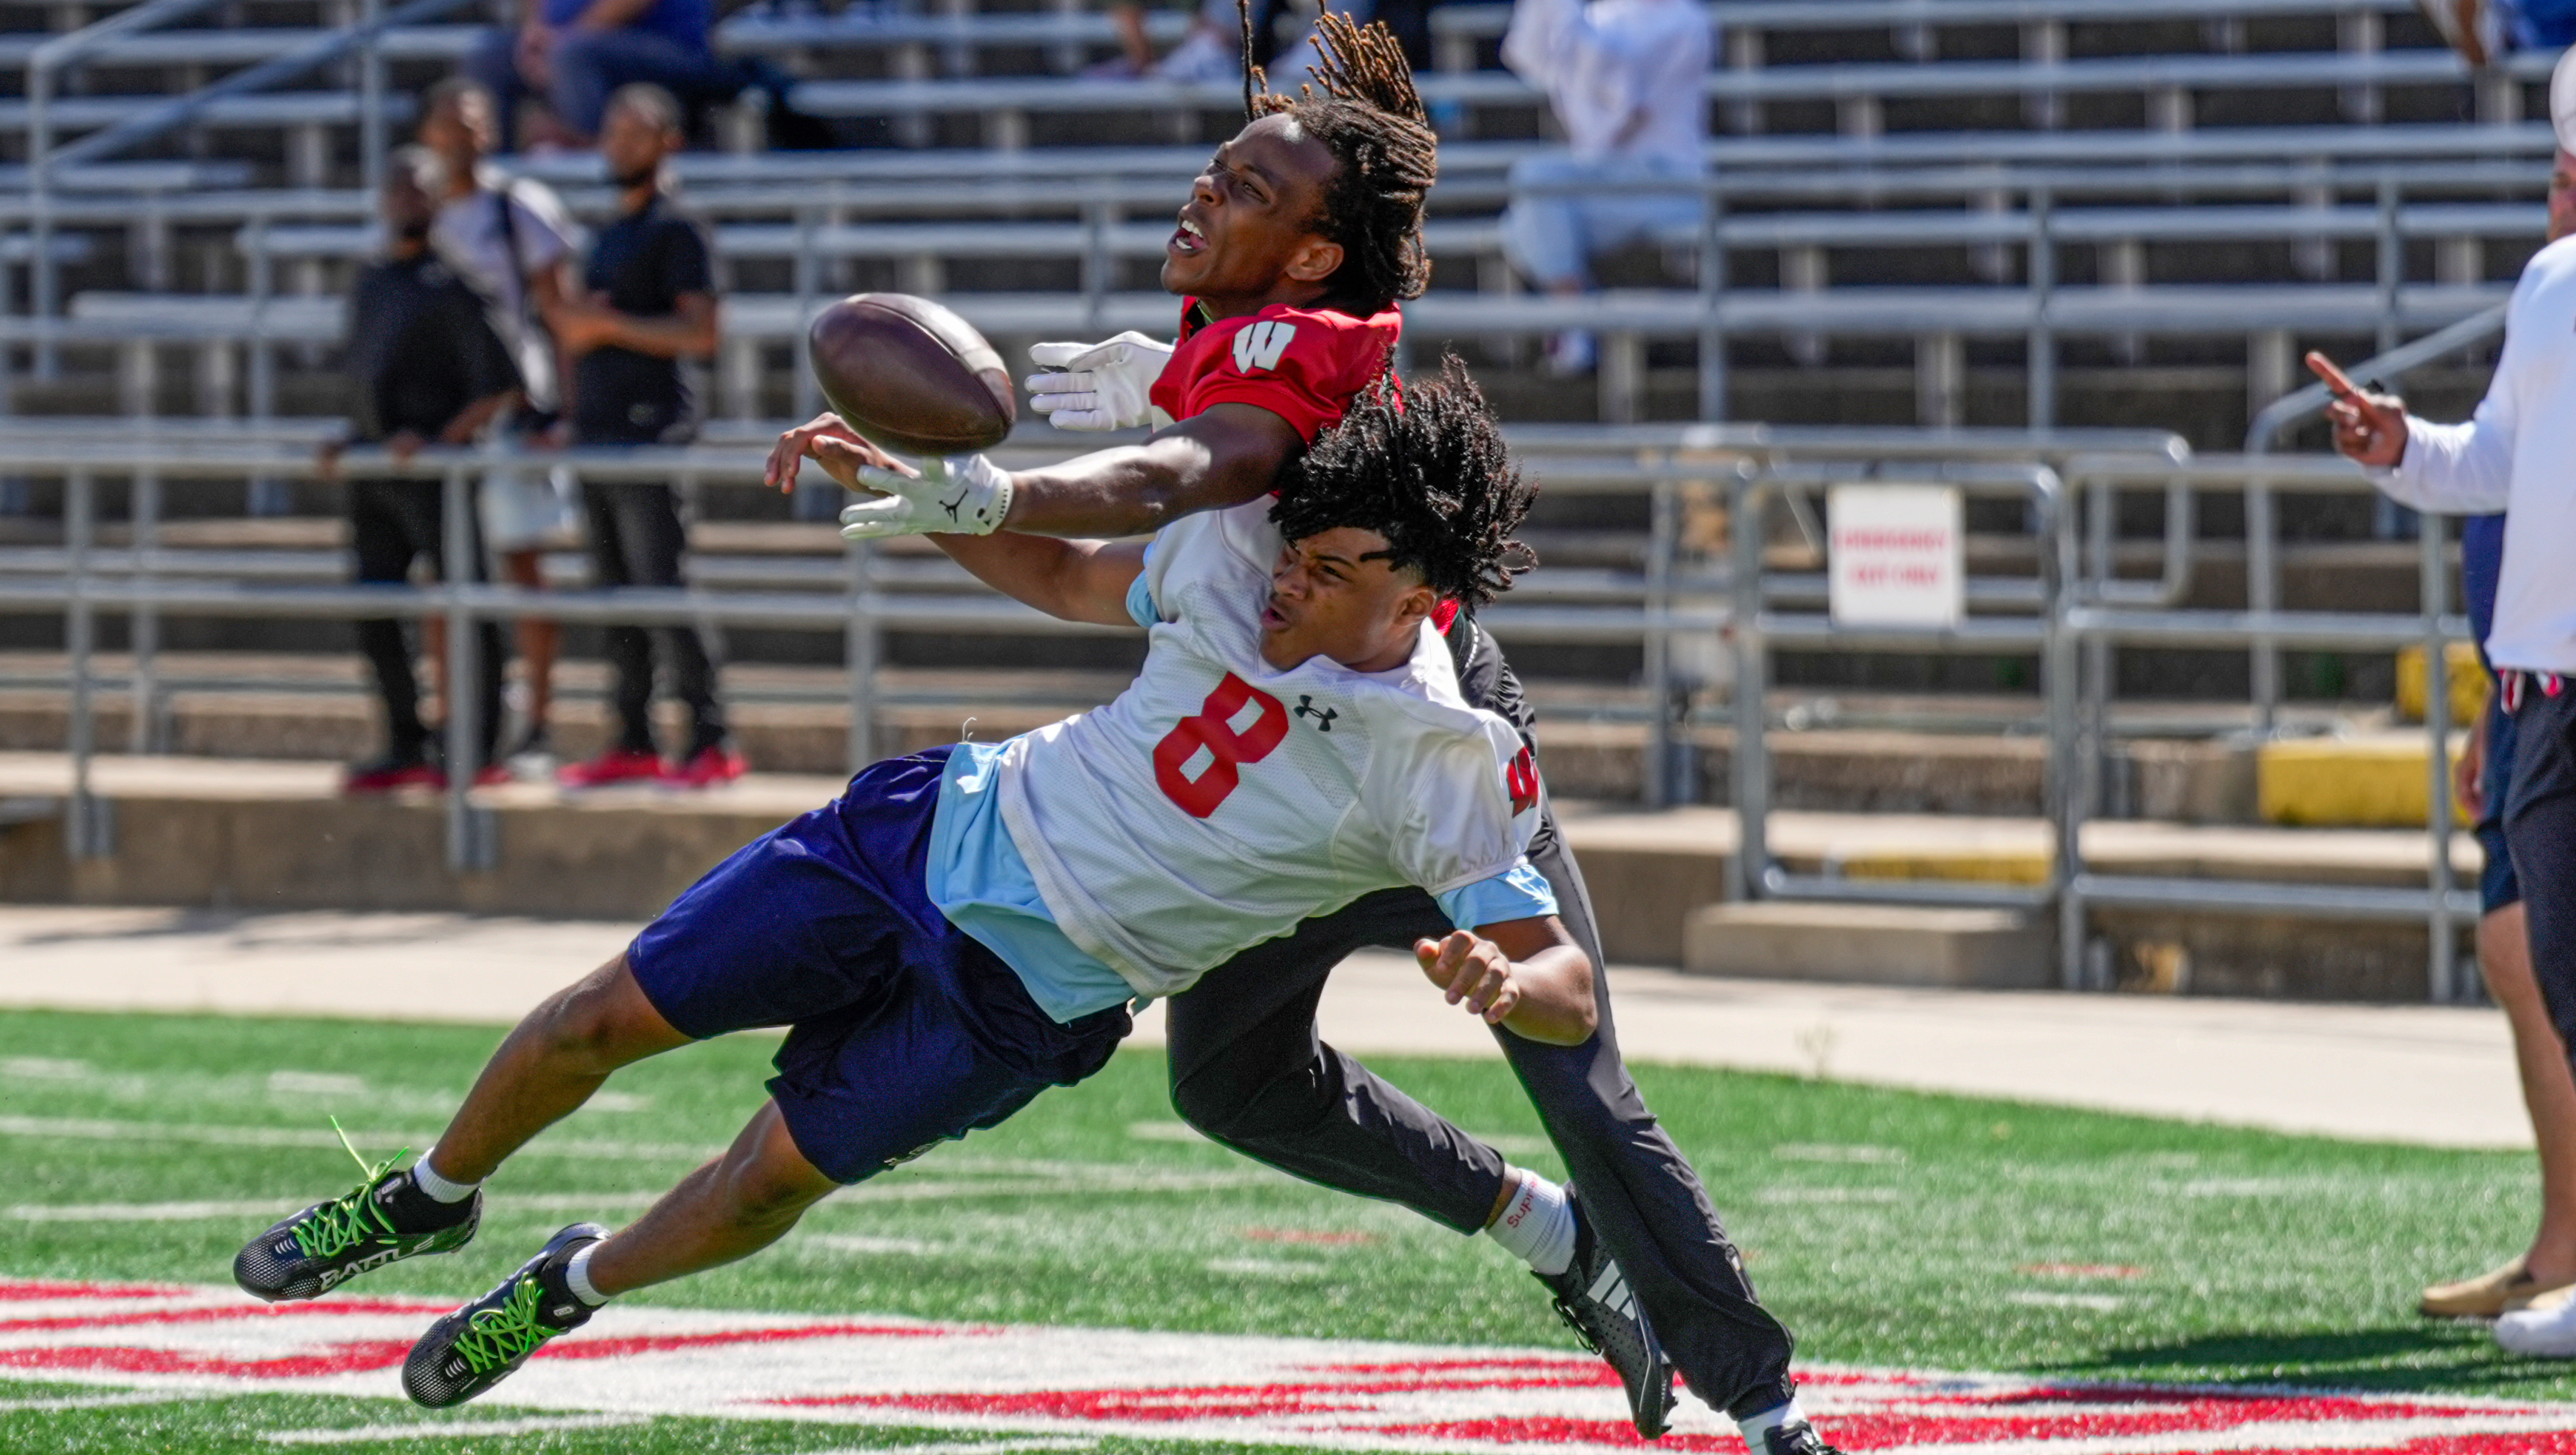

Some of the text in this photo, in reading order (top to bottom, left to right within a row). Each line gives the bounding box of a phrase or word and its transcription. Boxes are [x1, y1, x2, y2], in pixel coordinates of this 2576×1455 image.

[1232, 320, 1296, 374] W
[1152, 671, 1289, 819] 8
[319, 1234, 435, 1292] BATTLE
